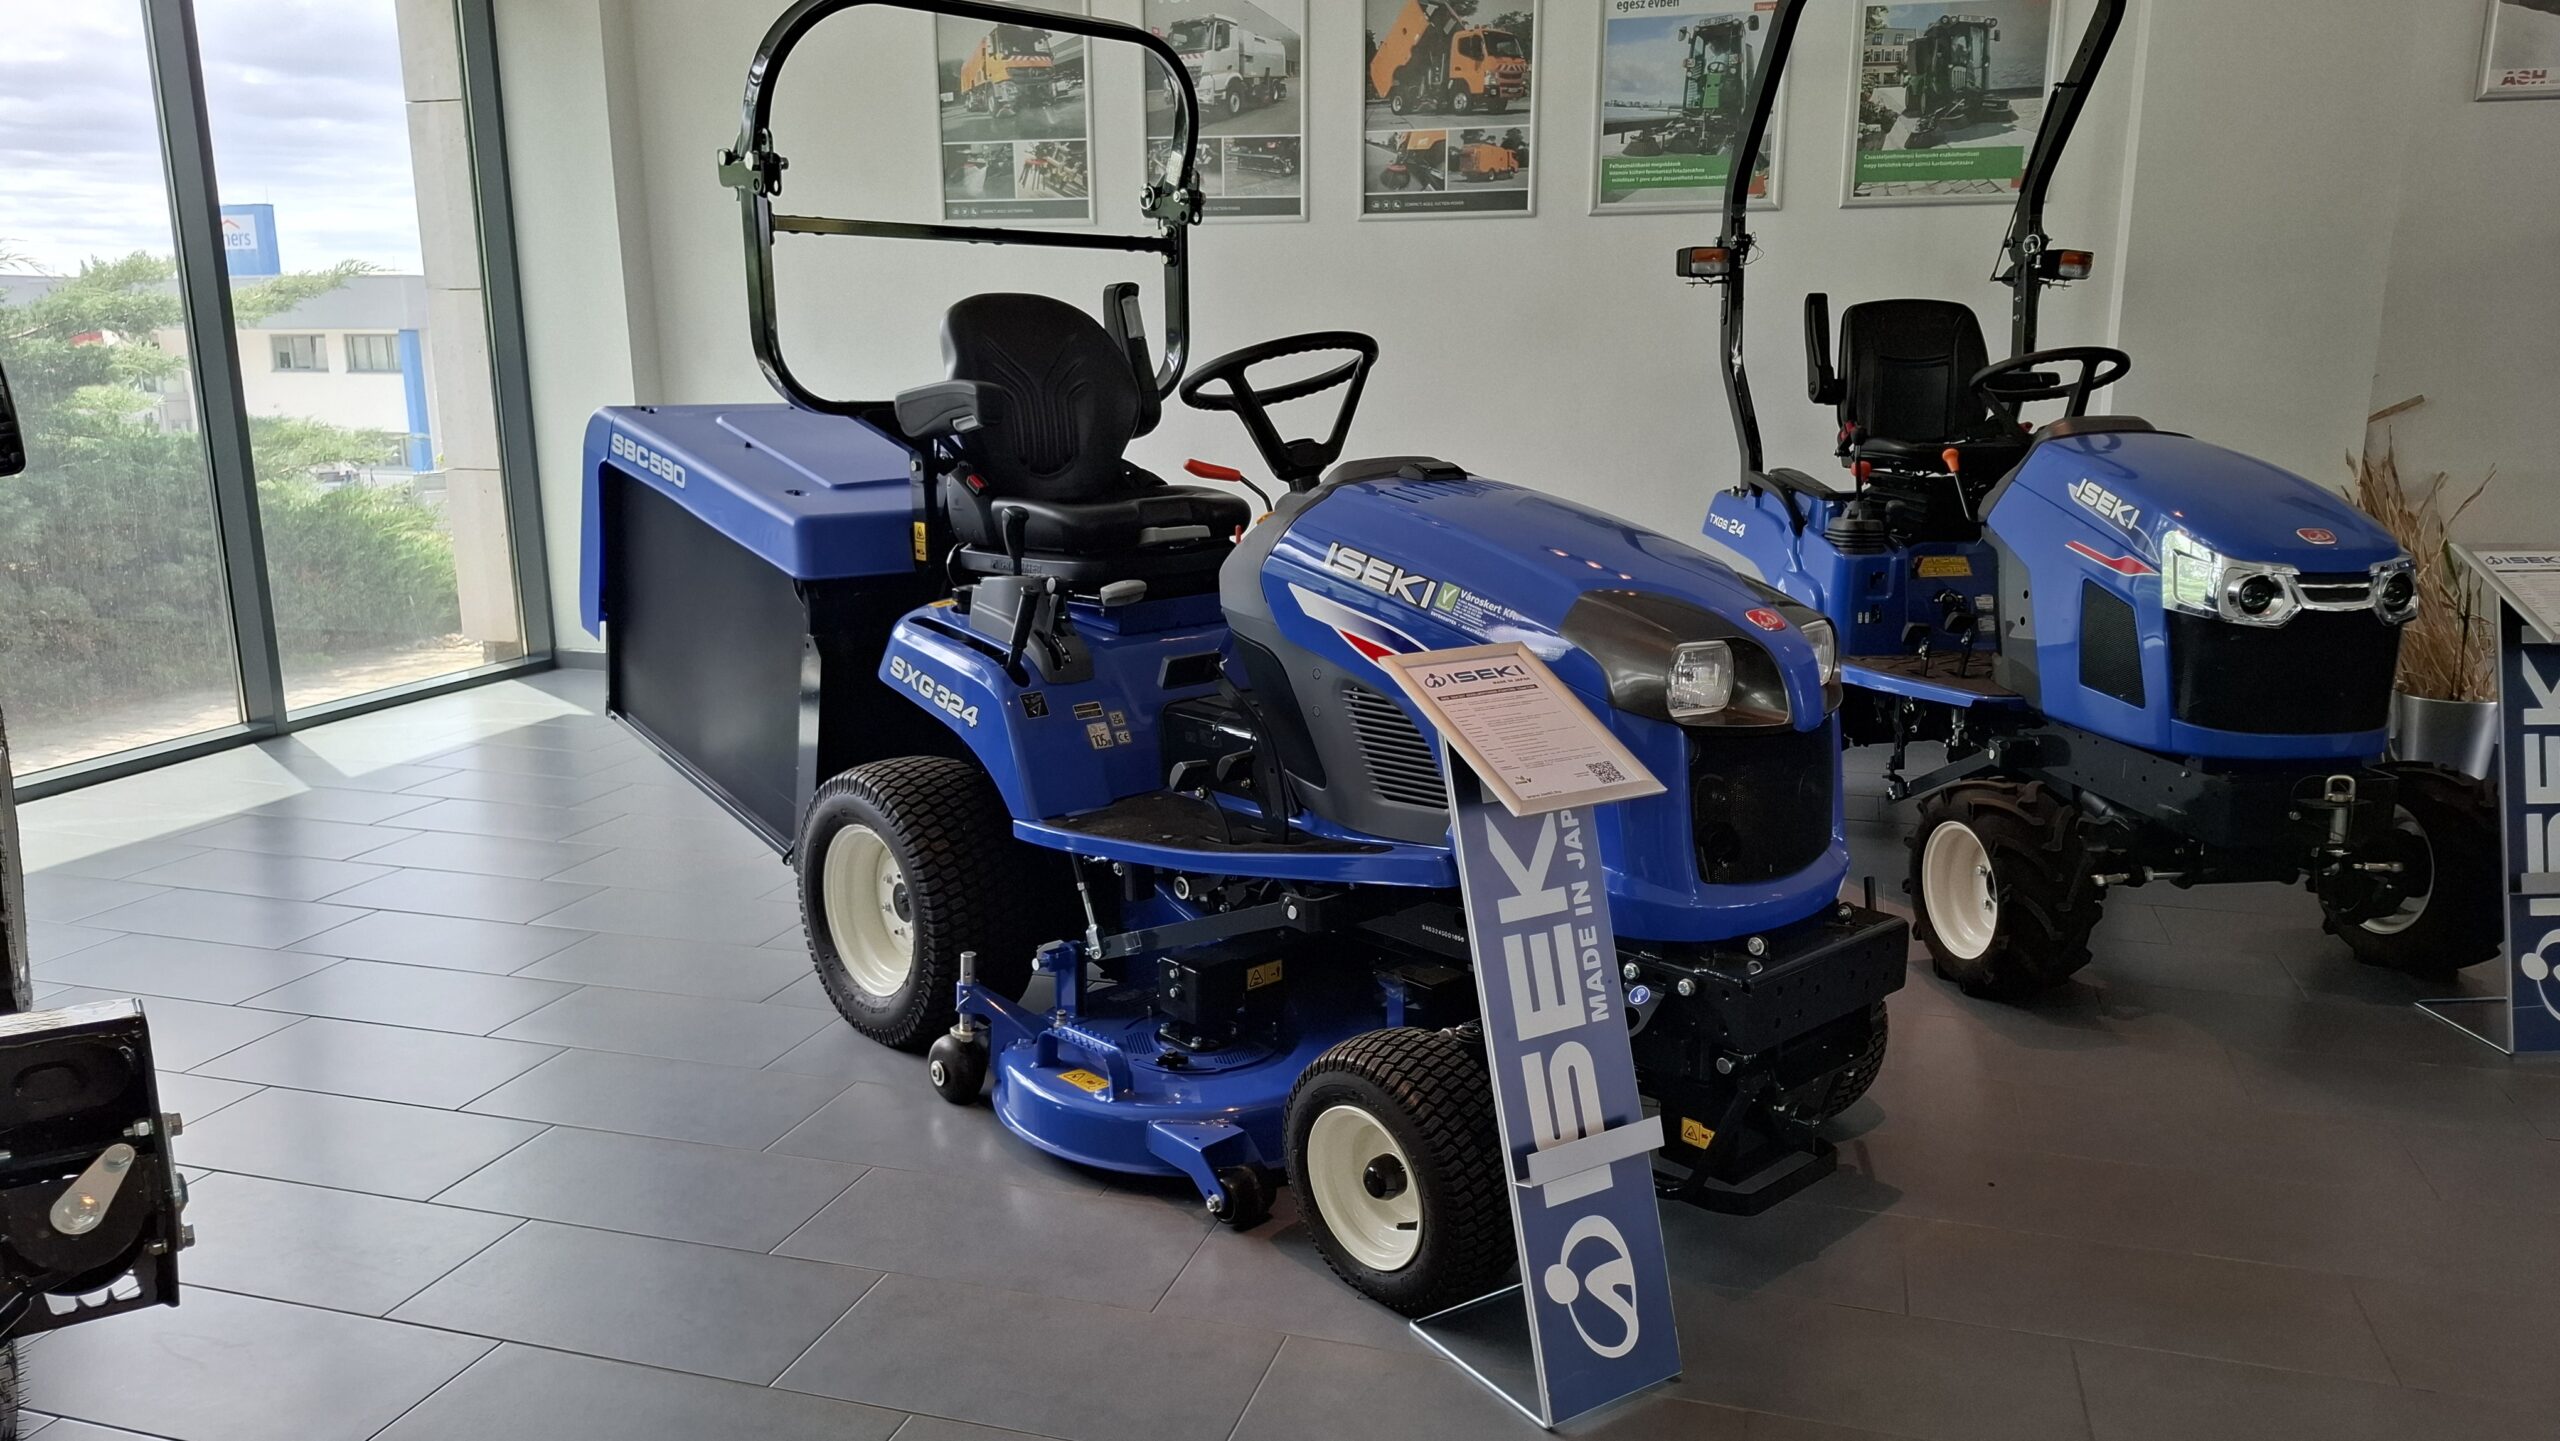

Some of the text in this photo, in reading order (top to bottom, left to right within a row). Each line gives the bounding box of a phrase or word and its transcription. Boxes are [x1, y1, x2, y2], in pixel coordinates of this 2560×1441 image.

[224, 233, 251, 247] ners
[612, 433, 686, 489] SBC590
[2075, 478, 2141, 530] ISEKI
[1728, 518, 1746, 538] 24
[1324, 541, 1437, 610] ISEKI
[2503, 555, 2560, 565] ISEK
[1461, 589, 1502, 613] Városkert
[889, 656, 980, 729] SXG324
[1446, 665, 1526, 684] ISEKI
[1118, 732, 1130, 742] CE
[1560, 809, 1610, 1022] MADE IN JAP
[1480, 780, 1613, 1209] ISEK
